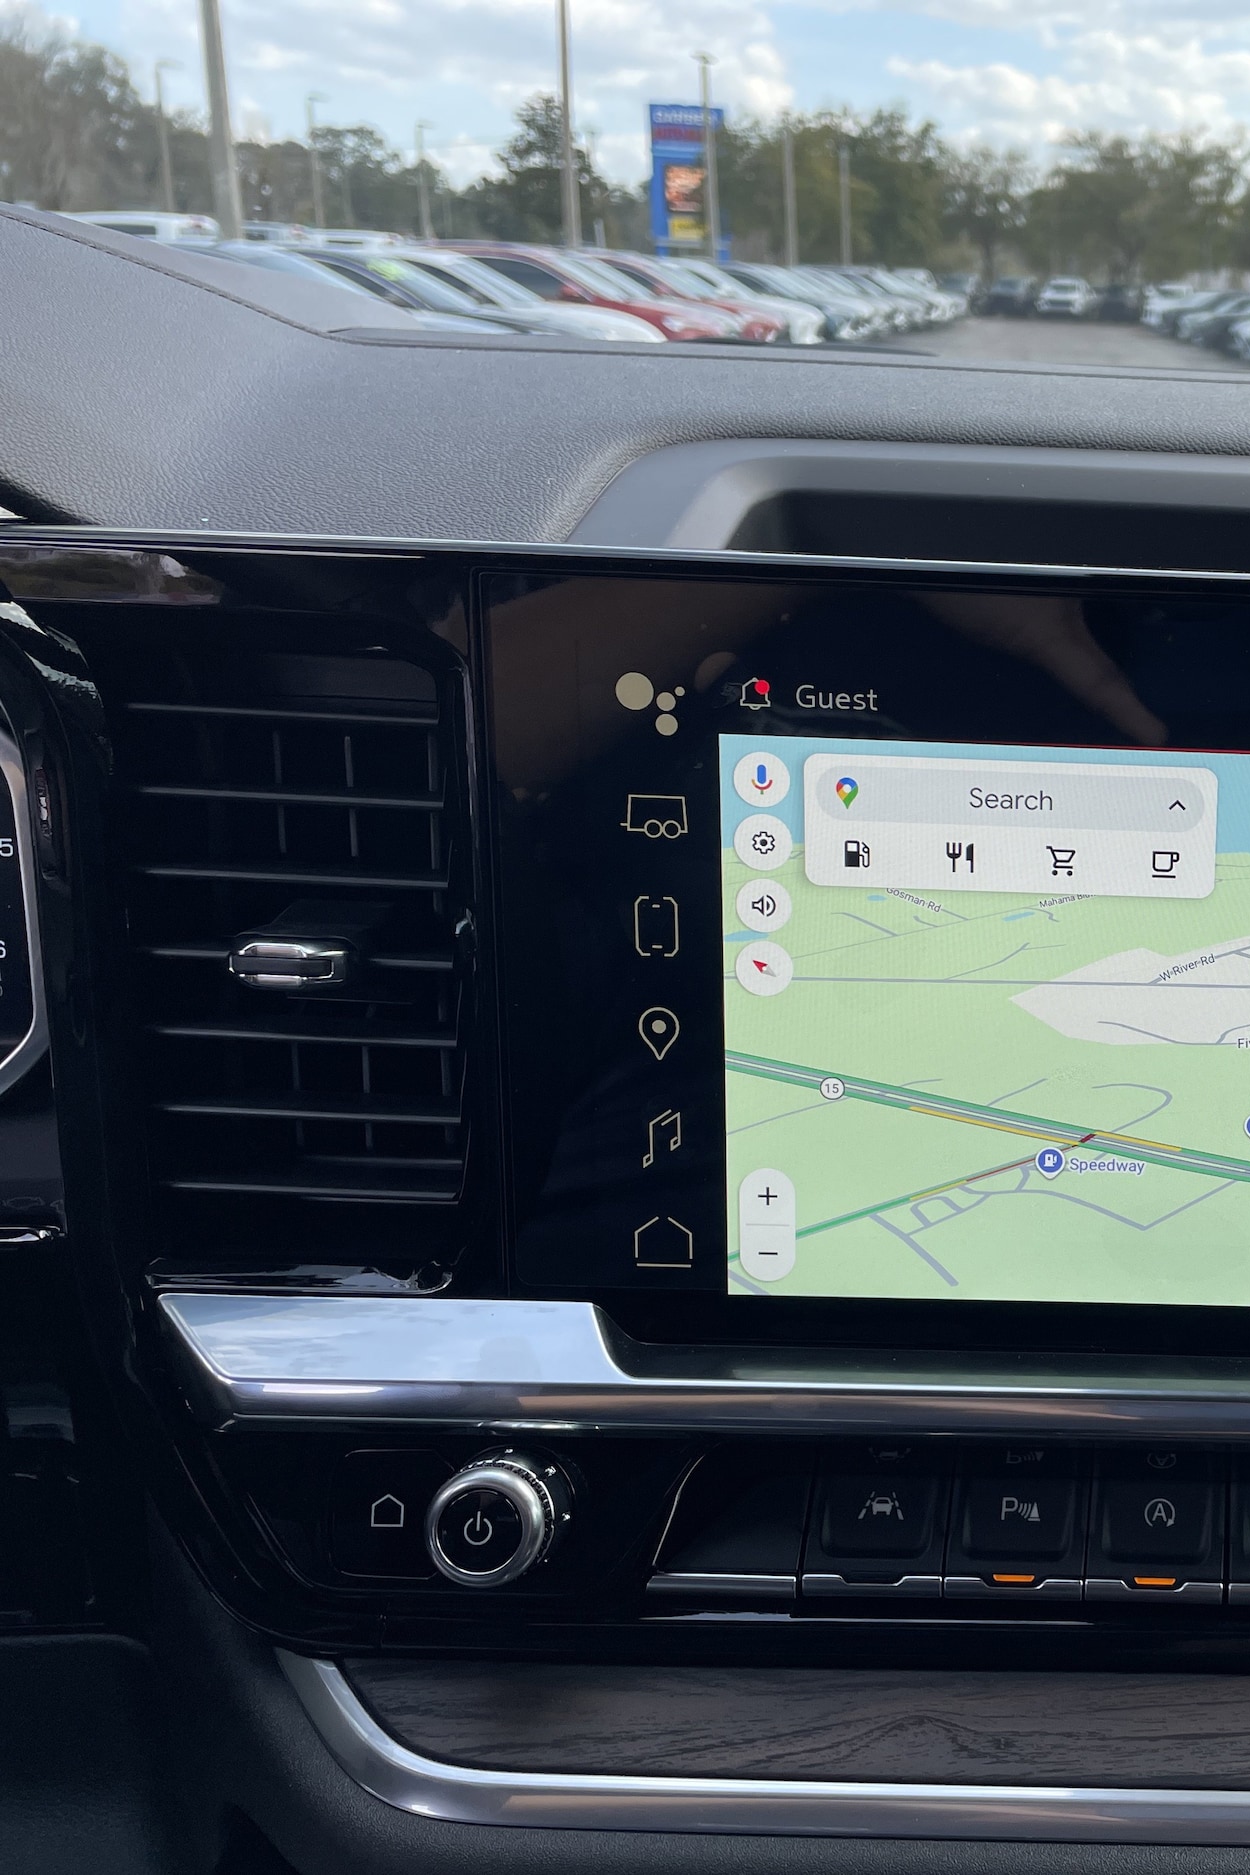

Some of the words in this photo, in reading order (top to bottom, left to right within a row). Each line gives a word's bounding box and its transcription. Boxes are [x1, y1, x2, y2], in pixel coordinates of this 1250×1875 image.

[795, 684, 878, 711] Guest
[969, 786, 1053, 812] Search
[927, 900, 942, 913] Rd
[1159, 970, 1172, 982] W
[1172, 960, 1200, 976] River
[1200, 953, 1216, 966] Rd
[824, 1083, 839, 1094] 15
[1069, 1157, 1146, 1176] Speedway
